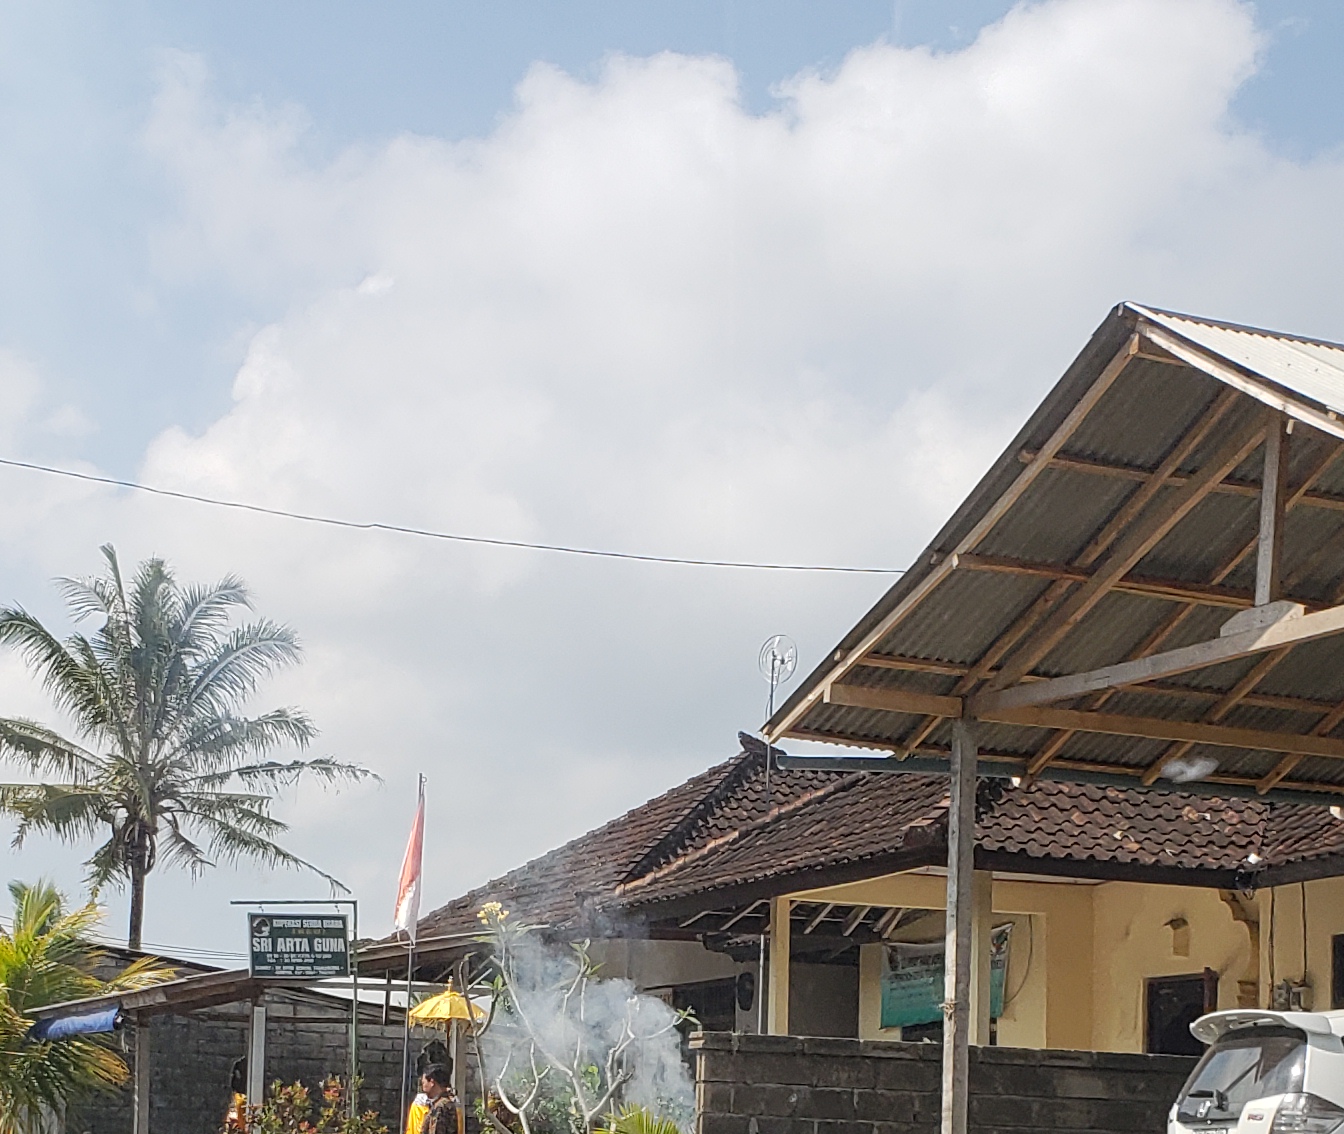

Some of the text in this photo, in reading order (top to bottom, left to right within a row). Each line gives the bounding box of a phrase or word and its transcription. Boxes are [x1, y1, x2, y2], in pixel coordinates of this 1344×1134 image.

[252, 937, 345, 952] SRI ARTA GUNA
